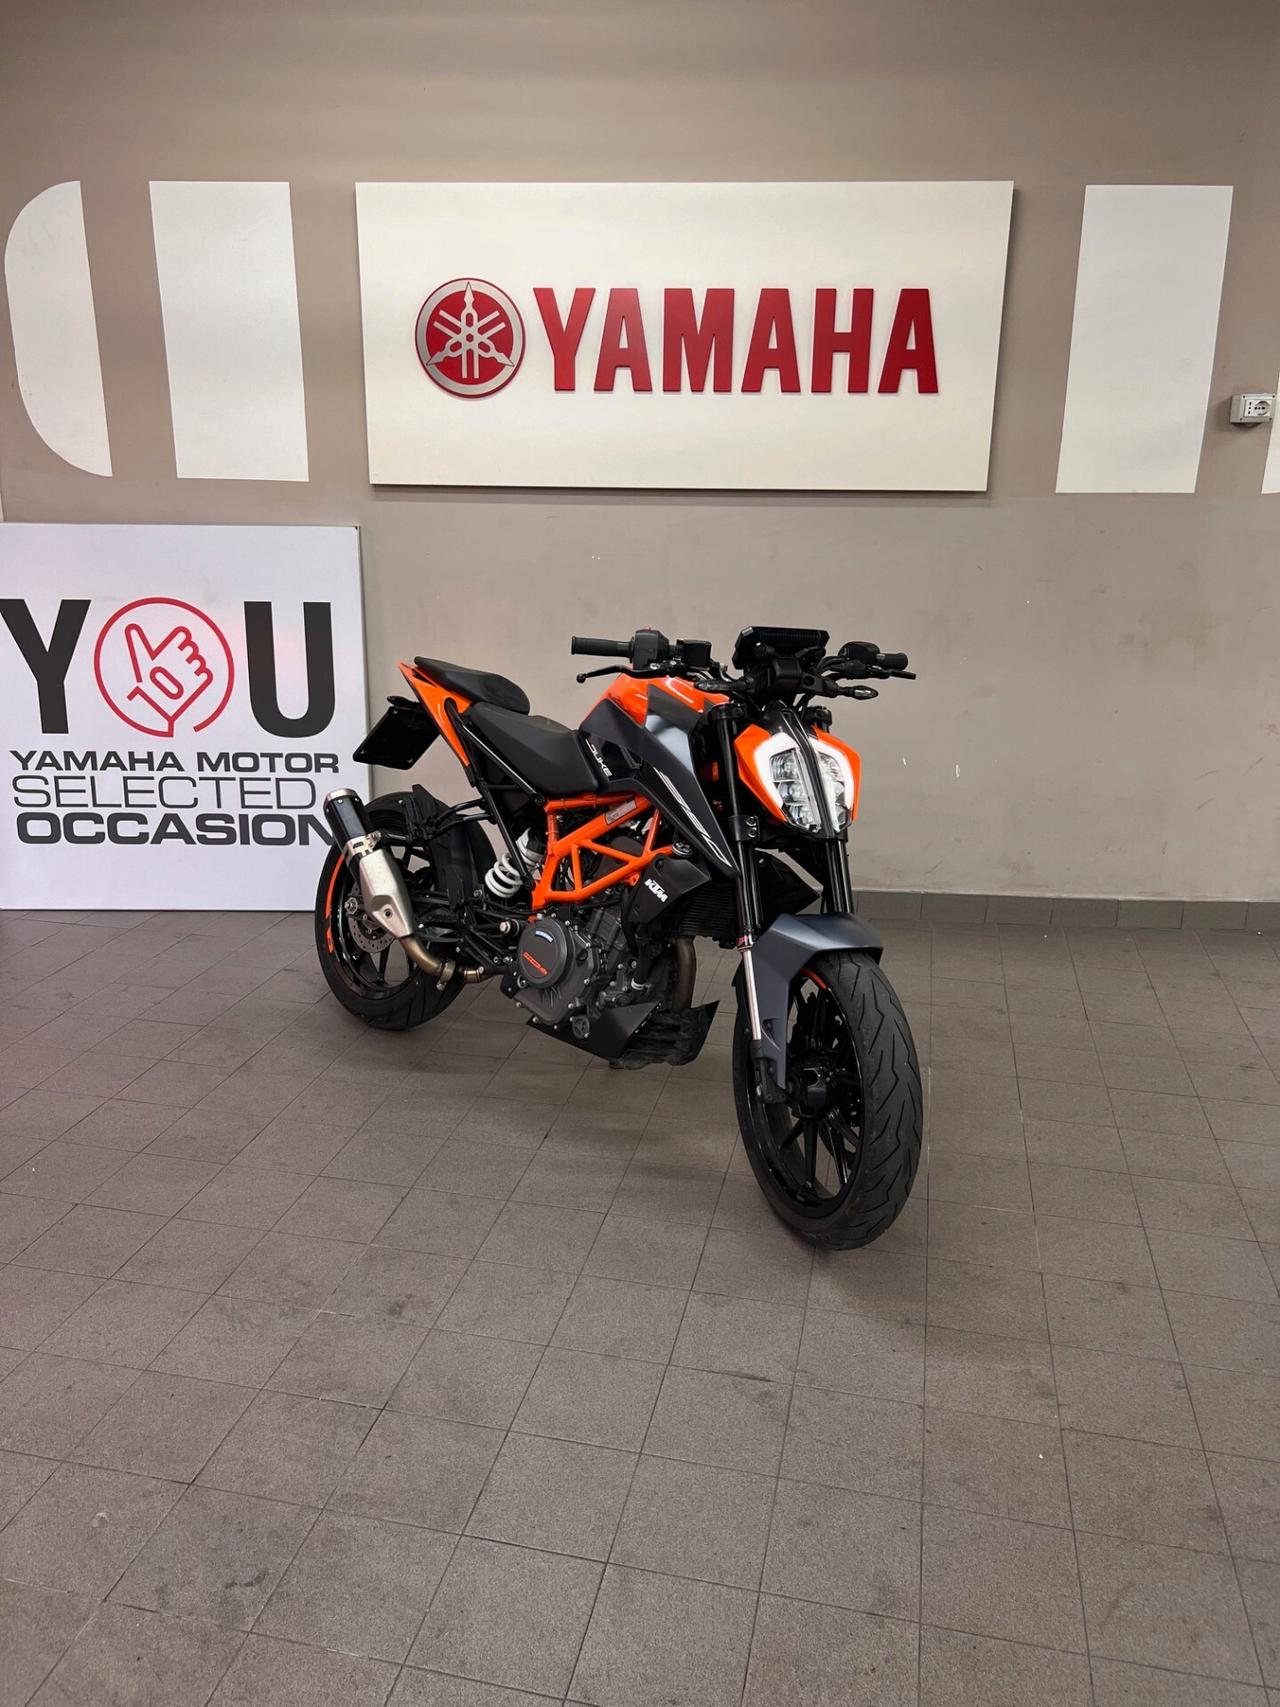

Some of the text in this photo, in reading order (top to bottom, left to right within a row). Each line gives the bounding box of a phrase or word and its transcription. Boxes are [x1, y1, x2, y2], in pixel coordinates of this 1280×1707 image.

[533, 287, 939, 394] YAMAHA
[10, 750, 339, 773] YAMAHA MOTOR
[585, 738, 613, 777] DUKE
[11, 775, 316, 810] SELECTED
[644, 878, 668, 902] KTM
